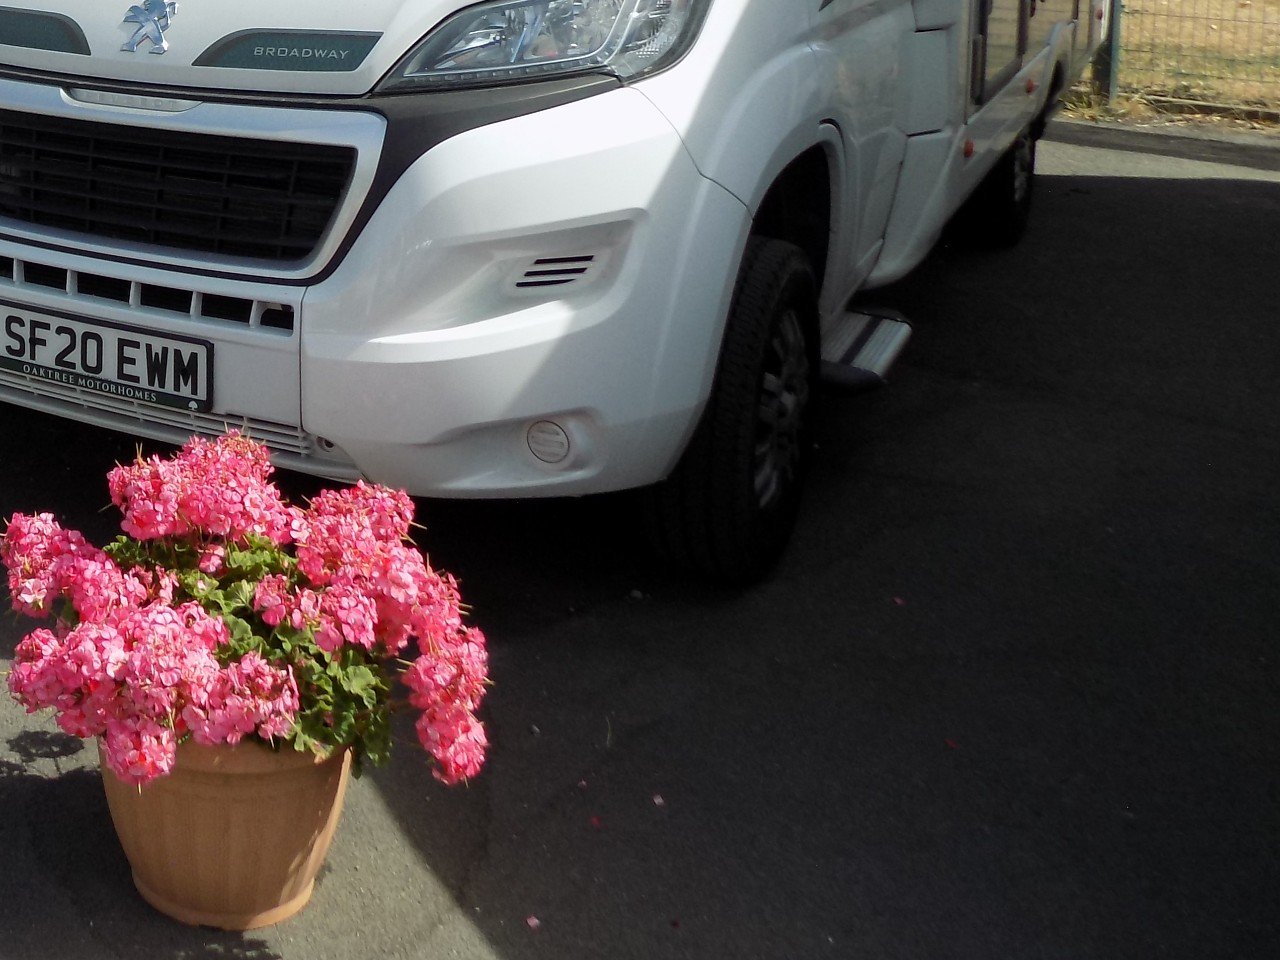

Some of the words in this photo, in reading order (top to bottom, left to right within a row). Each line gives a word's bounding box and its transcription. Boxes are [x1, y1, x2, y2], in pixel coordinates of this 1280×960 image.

[254, 47, 349, 59] BROADWAY
[5, 315, 104, 375] SF20
[116, 337, 199, 396] EWM
[22, 364, 75, 384] OAKTREE
[77, 377, 157, 402] MOTORHOMES
